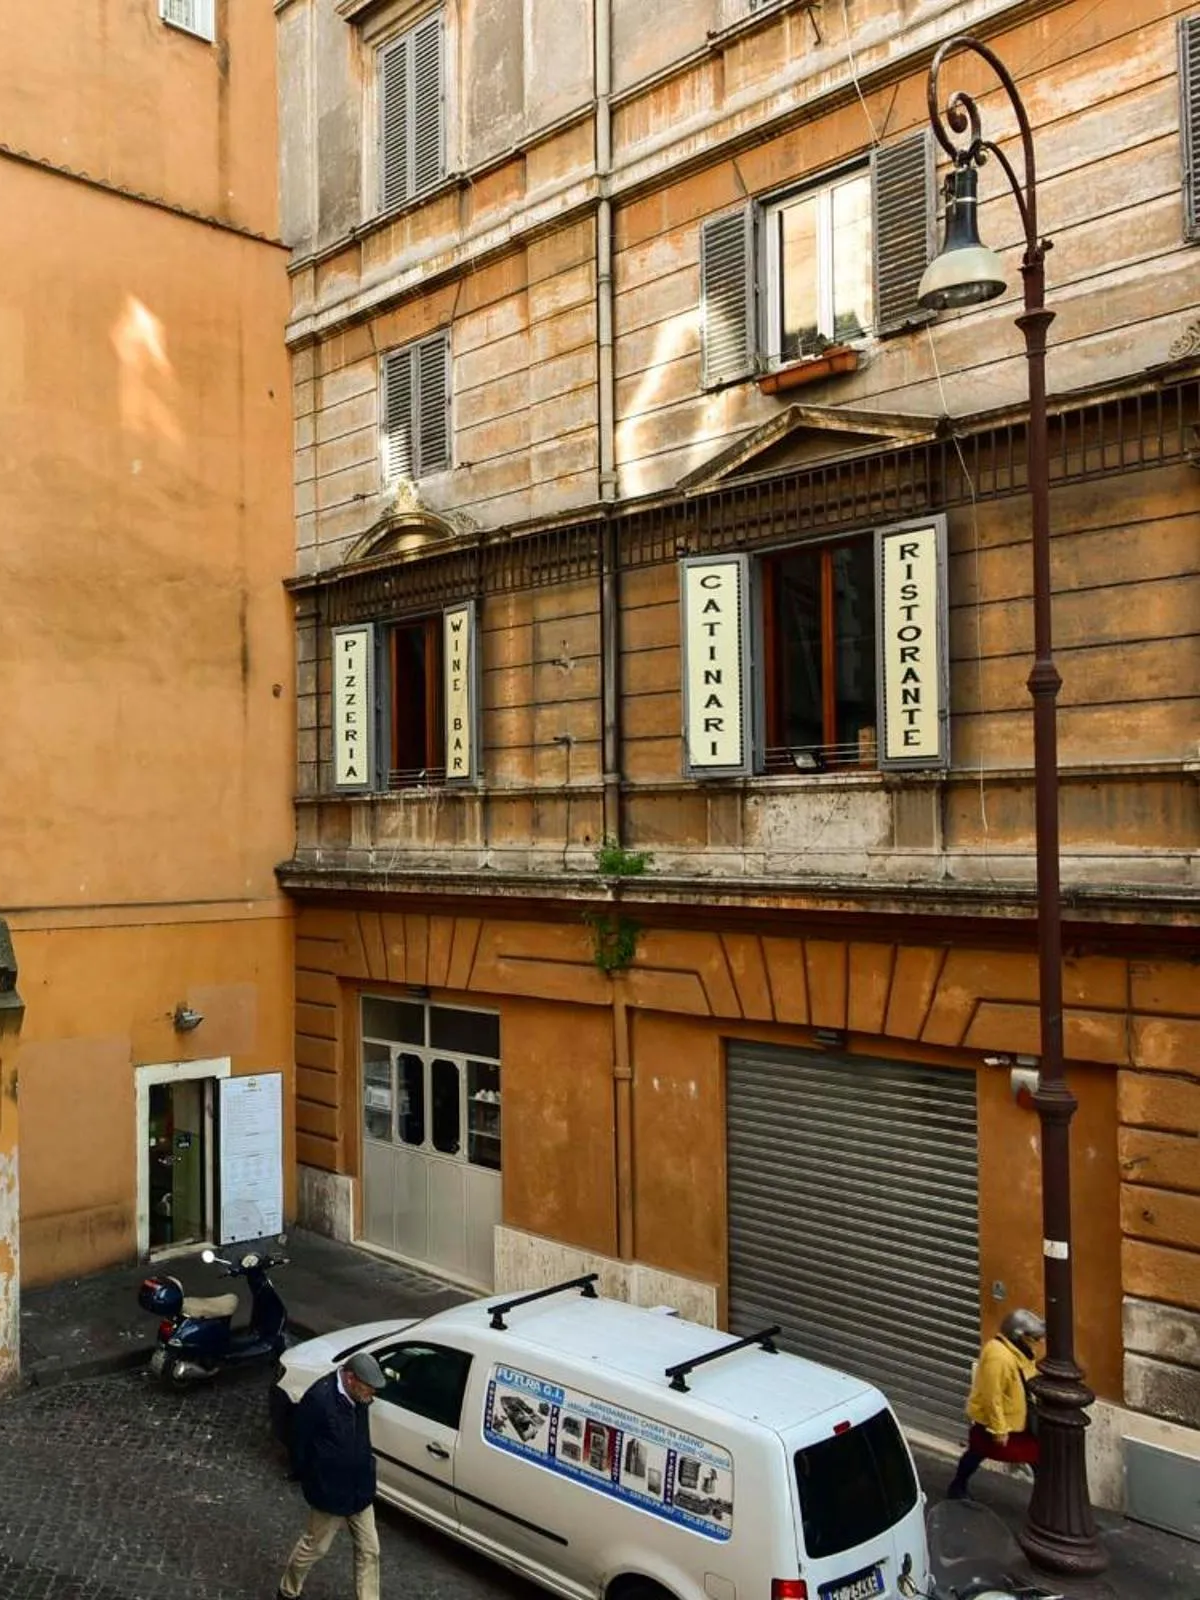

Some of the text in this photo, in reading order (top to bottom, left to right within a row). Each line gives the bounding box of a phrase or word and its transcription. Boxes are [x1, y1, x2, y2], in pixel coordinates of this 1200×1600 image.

[344, 640, 358, 778] PIZZERIA
[450, 619, 464, 771] WINE BAR
[700, 575, 725, 757] CATINARI
[897, 542, 922, 747] RISTORANTE
[497, 1368, 541, 1391] FUTURA
[549, 1407, 559, 1454] FORNI
